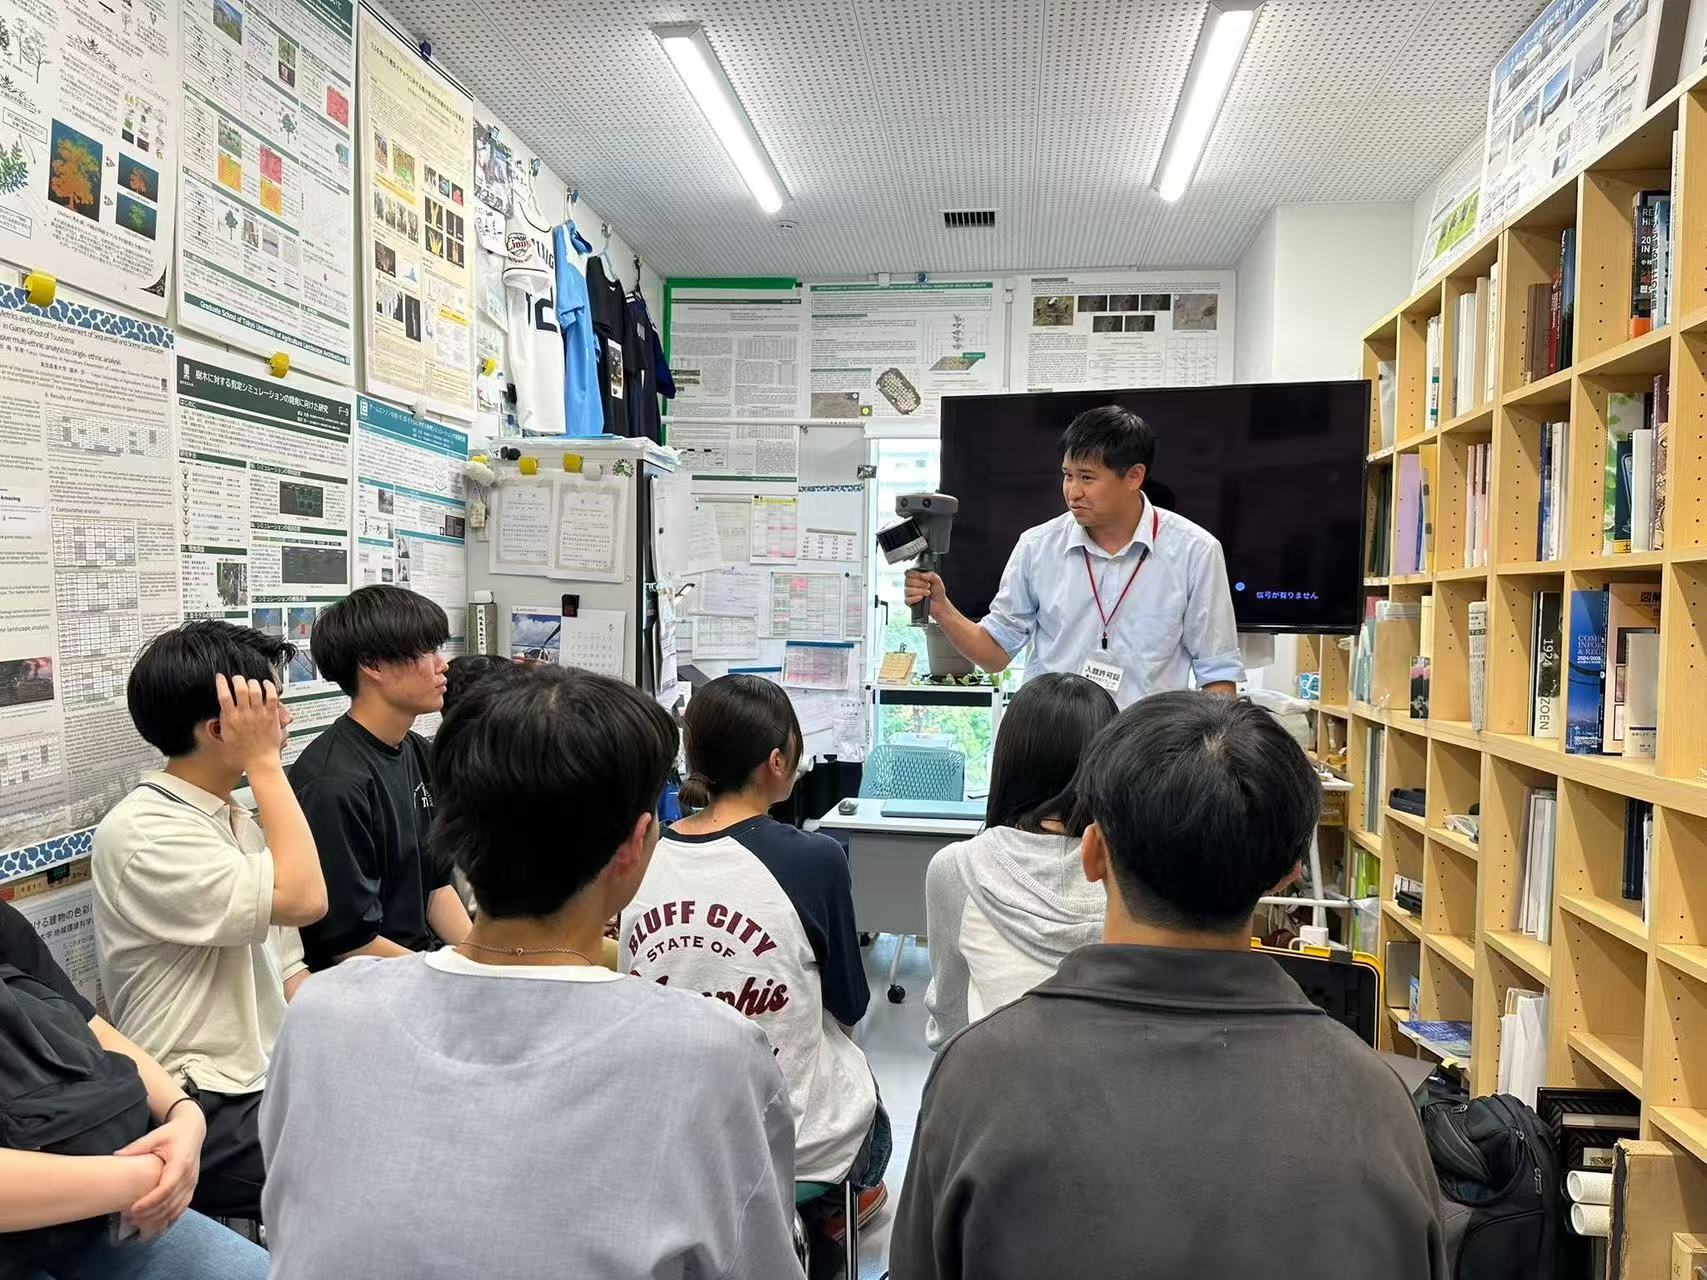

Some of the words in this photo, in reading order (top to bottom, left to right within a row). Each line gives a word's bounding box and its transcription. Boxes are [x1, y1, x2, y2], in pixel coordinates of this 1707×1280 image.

[201, 301, 221, 315] Graduate
[222, 307, 235, 319] School
[6, 324, 27, 335] Game
[27, 327, 46, 338] Ghost
[30, 316, 57, 330] Subjective
[628, 901, 696, 957] BLUFF
[706, 903, 777, 957] CITY
[646, 935, 704, 962] STATE
[711, 941, 736, 958] OF
